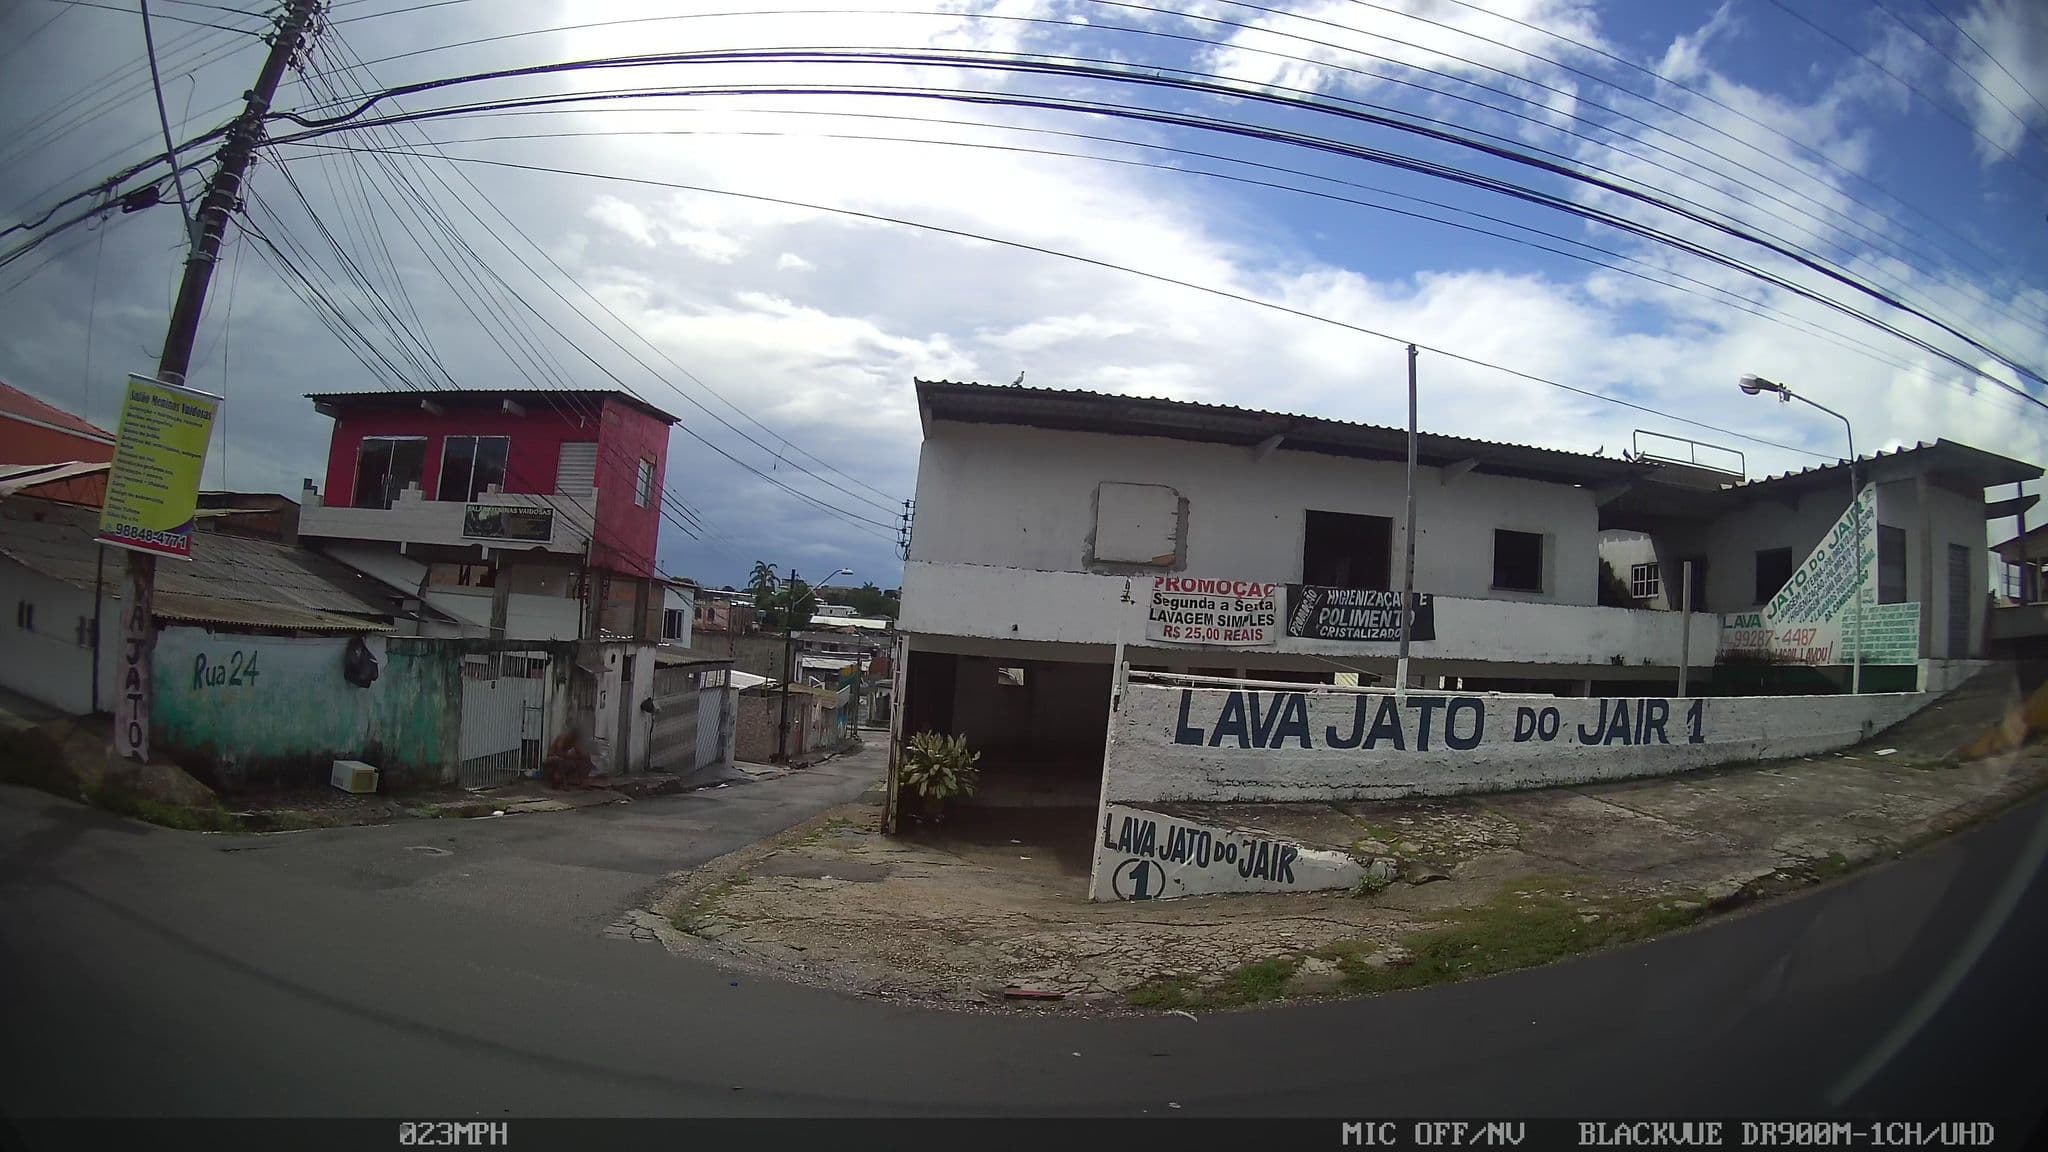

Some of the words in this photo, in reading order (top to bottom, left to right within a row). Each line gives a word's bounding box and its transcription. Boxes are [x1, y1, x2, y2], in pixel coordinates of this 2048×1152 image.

[115, 522, 187, 550] 98848-4771
[1152, 592, 1215, 610] Segunda
[1220, 602, 1229, 611] a
[1420, 593, 1428, 606] E
[1722, 614, 1761, 629] LAVA
[1767, 570, 1807, 619] JATO
[1809, 550, 1825, 571] DO
[1149, 608, 1214, 626] LAVAGEM
[1217, 613, 1275, 627] SIMPLES
[1163, 625, 1181, 639] R$
[1184, 627, 1220, 642] 25,00
[1223, 629, 1264, 641] REAIS
[1320, 625, 1401, 639] CRISTALIZADO
[194, 653, 225, 690] Rua
[229, 650, 260, 687] 24
[1174, 692, 1313, 748] LAVA
[1326, 697, 1485, 751] JATO
[1514, 706, 1560, 742] DO
[1577, 698, 1669, 746] JAIR
[1687, 698, 1704, 743] 1
[1104, 813, 1157, 858] LAVA
[1159, 825, 1212, 868] JATO
[1213, 840, 1237, 864] DO
[1238, 840, 1300, 884] JAIR
[1129, 860, 1152, 900] 1
